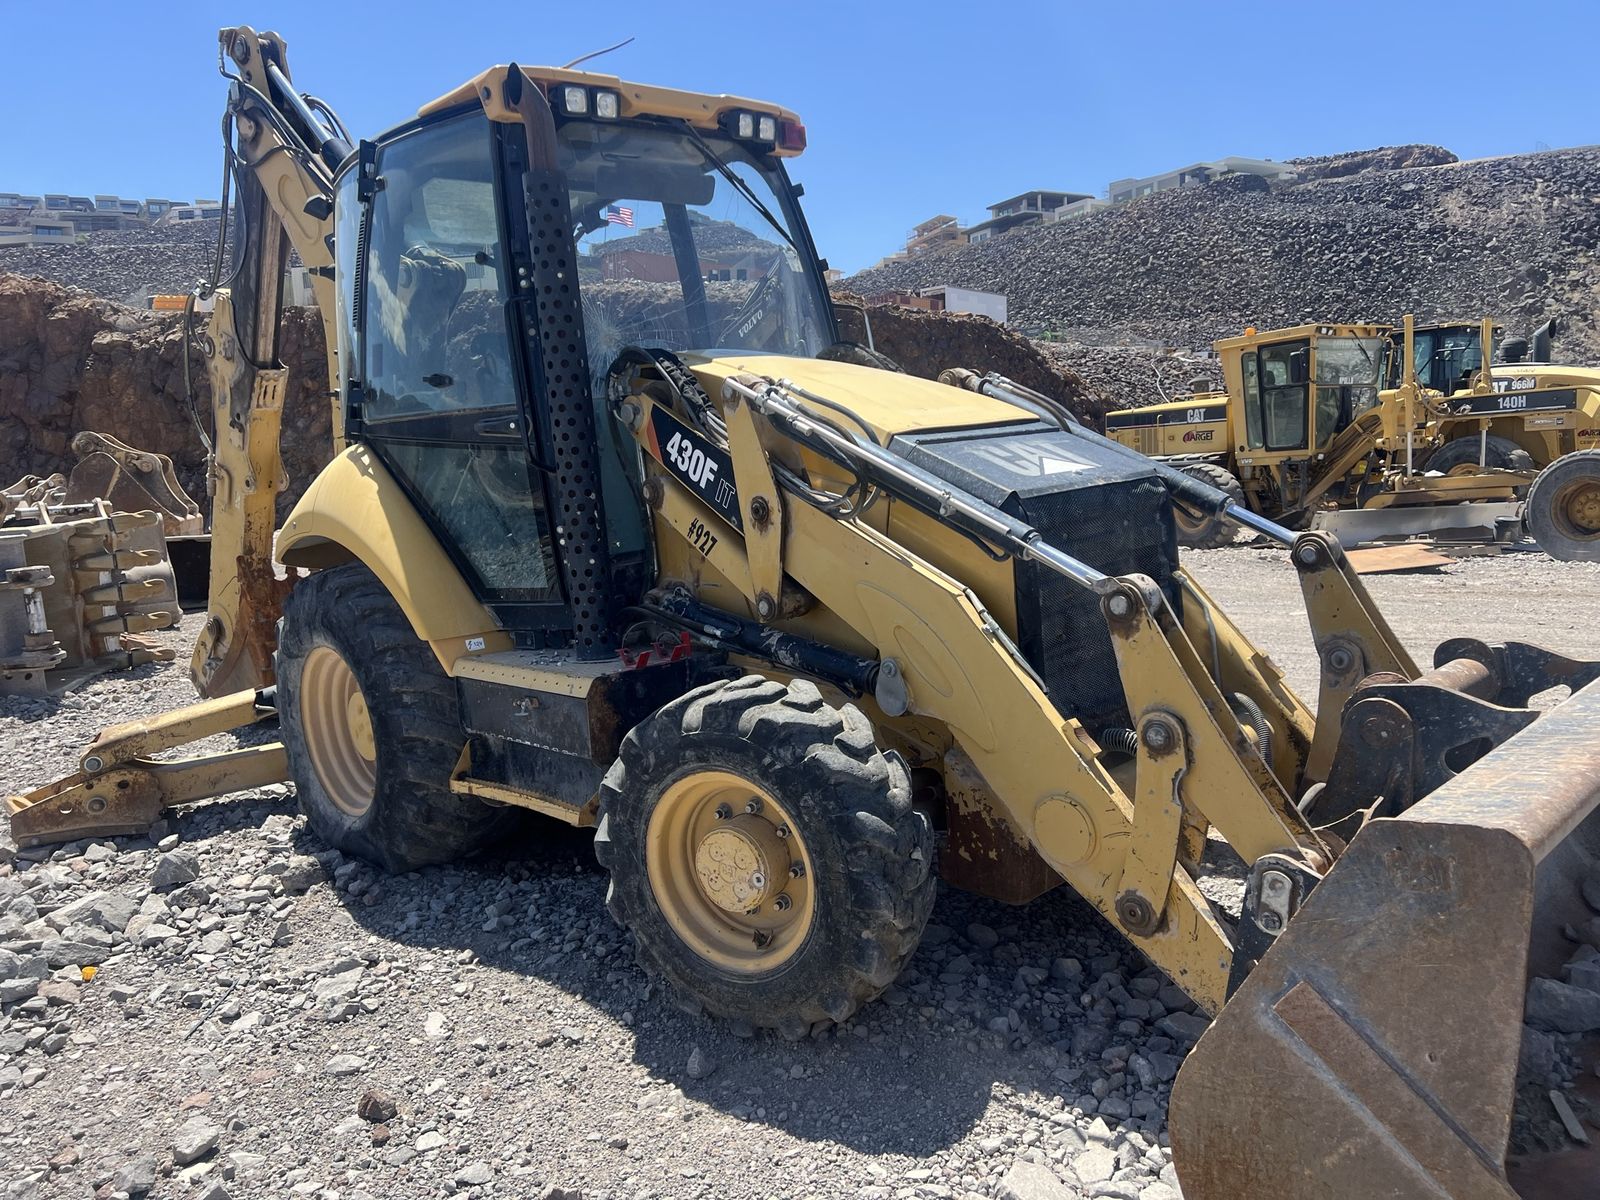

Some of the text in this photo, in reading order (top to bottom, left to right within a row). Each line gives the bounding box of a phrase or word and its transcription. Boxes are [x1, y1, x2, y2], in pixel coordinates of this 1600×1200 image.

[739, 309, 763, 338] VOLVO
[1492, 378, 1535, 394] AT 966M
[1186, 408, 1206, 423] CAT
[1497, 395, 1527, 409] 140H
[666, 431, 736, 510] 430F IT
[961, 439, 1102, 477] CAT
[686, 517, 718, 557] #927
